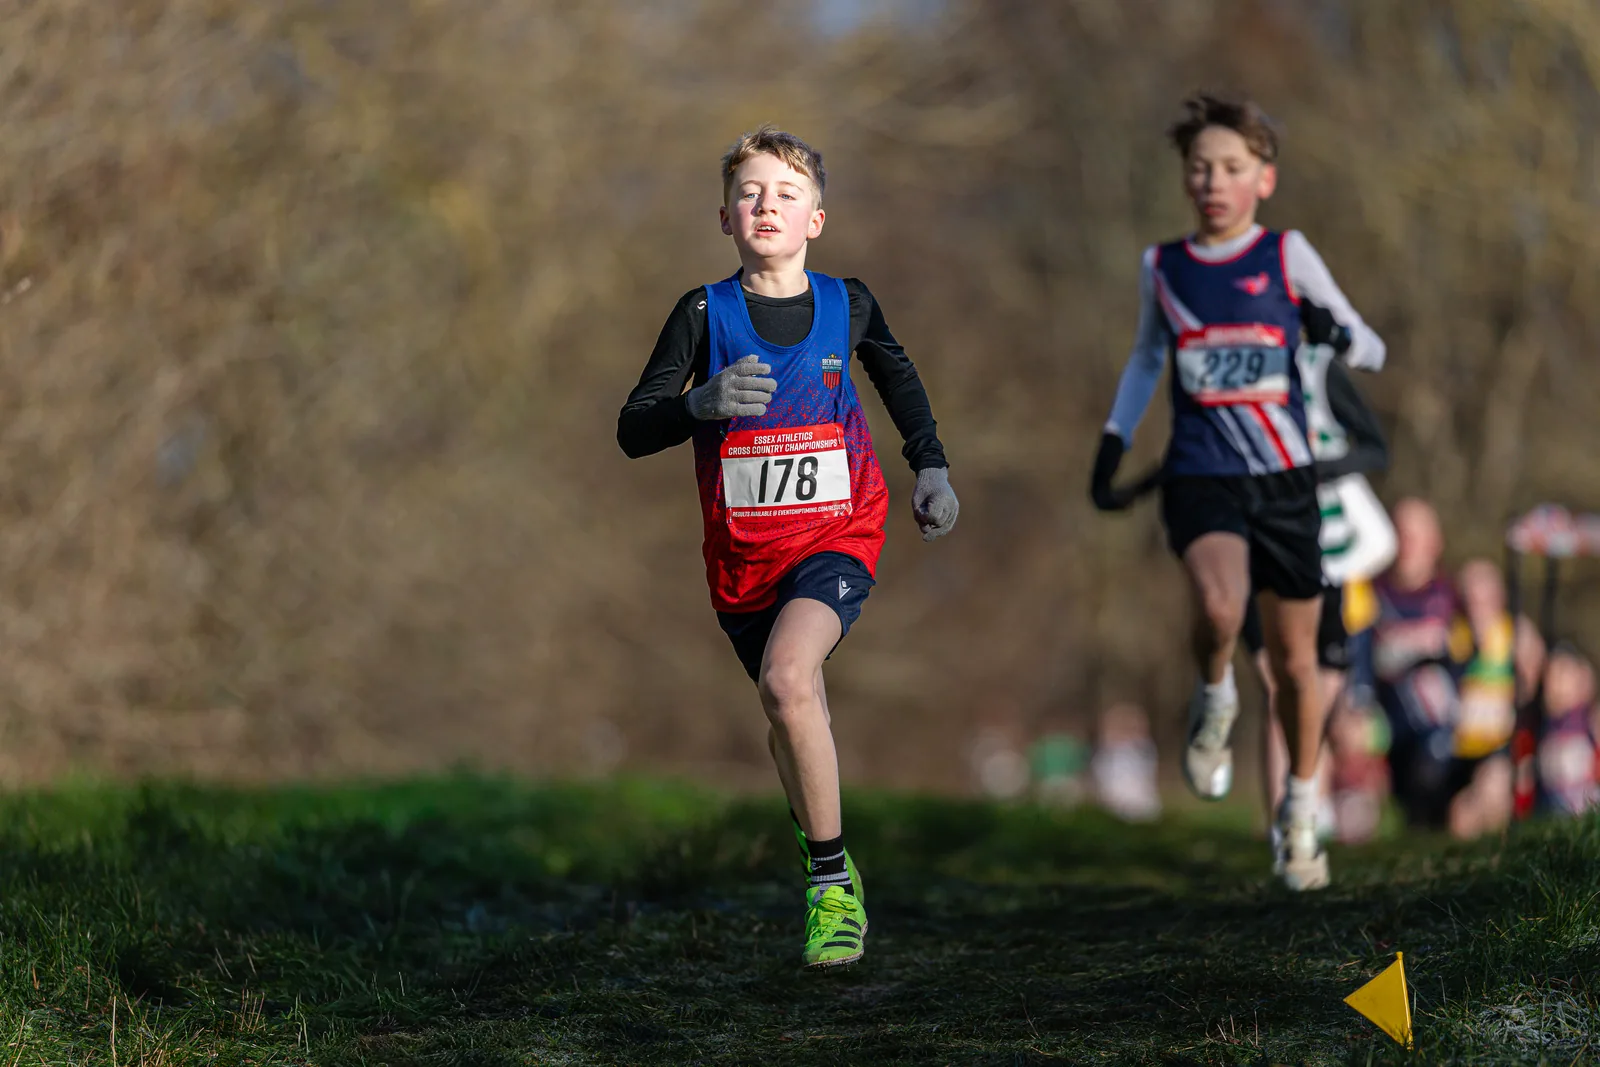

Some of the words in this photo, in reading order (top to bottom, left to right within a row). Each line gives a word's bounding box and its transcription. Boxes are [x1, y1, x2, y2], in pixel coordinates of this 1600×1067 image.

[1199, 351, 1265, 388] 229
[728, 446, 750, 456] CROSS
[752, 444, 784, 454] COUNTRY
[785, 438, 837, 452] CHAMPIONSHIPS
[754, 435, 775, 445] ESSEX
[776, 432, 813, 443] ATHLETICS
[758, 456, 818, 503] 178
